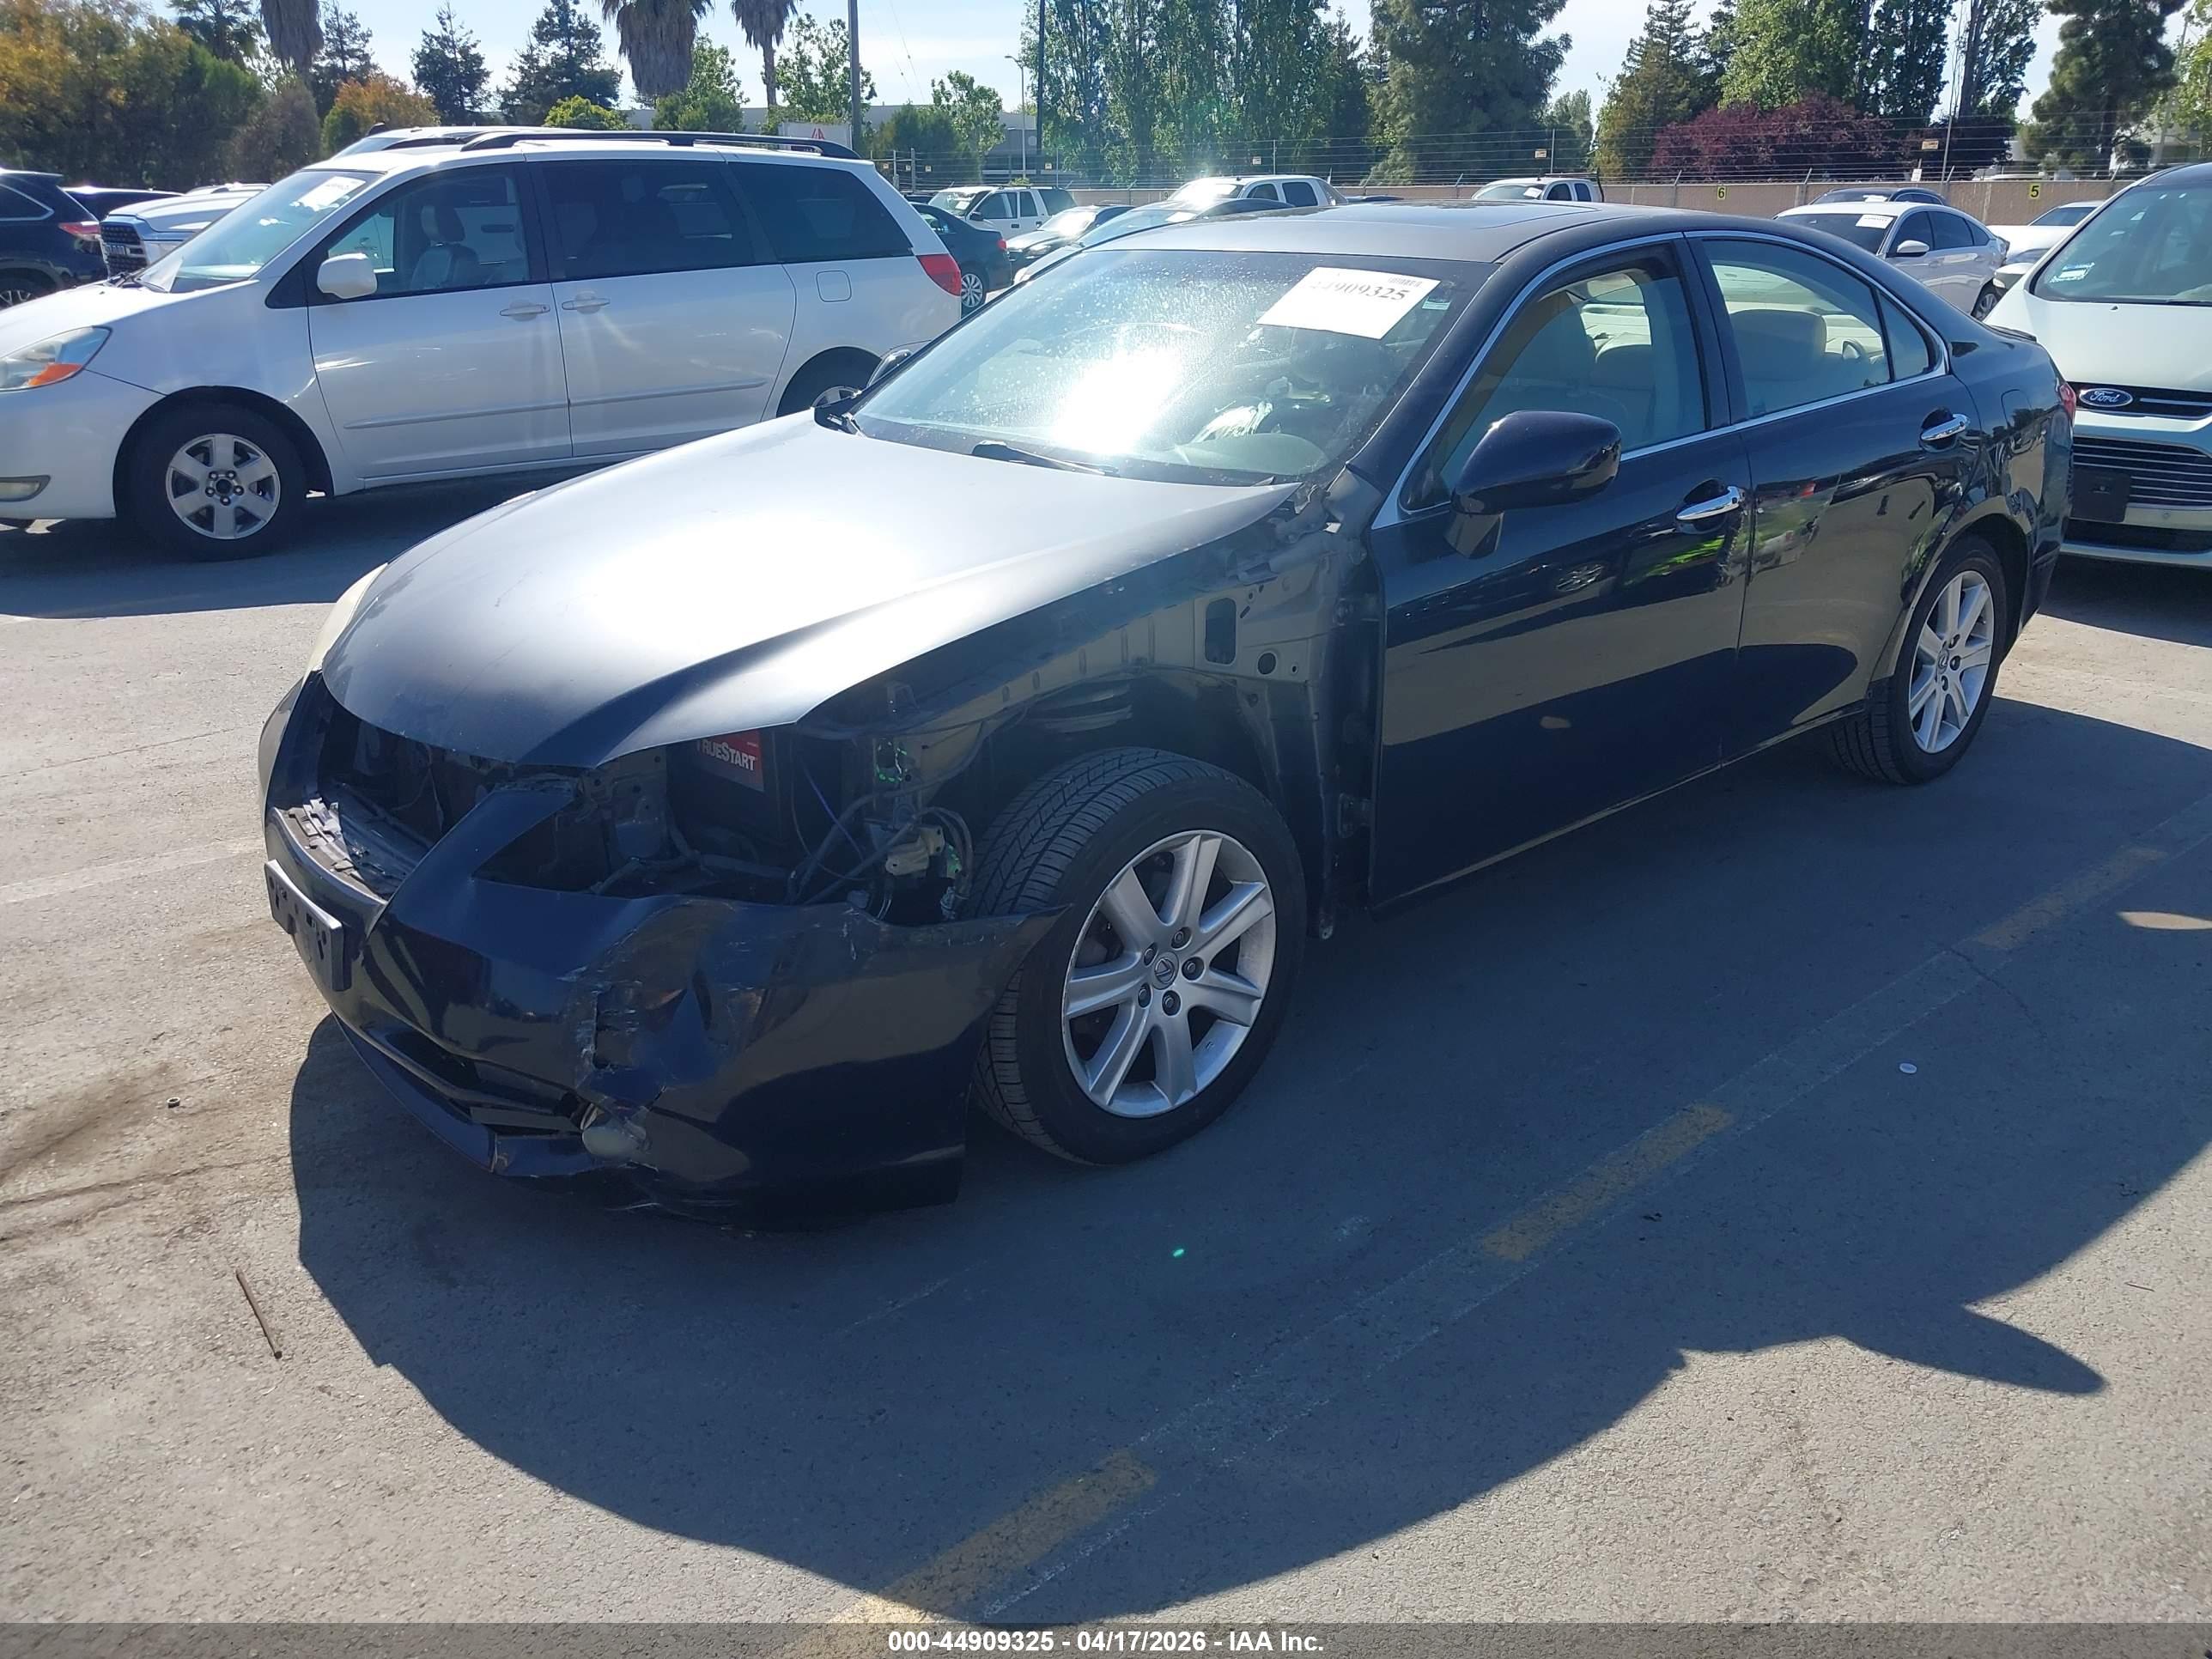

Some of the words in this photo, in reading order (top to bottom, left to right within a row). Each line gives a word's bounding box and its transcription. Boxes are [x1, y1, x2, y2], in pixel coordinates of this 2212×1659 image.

[1717, 187, 1725, 198] 6
[2030, 185, 2040, 198] 5
[2089, 390, 2121, 403] Ford
